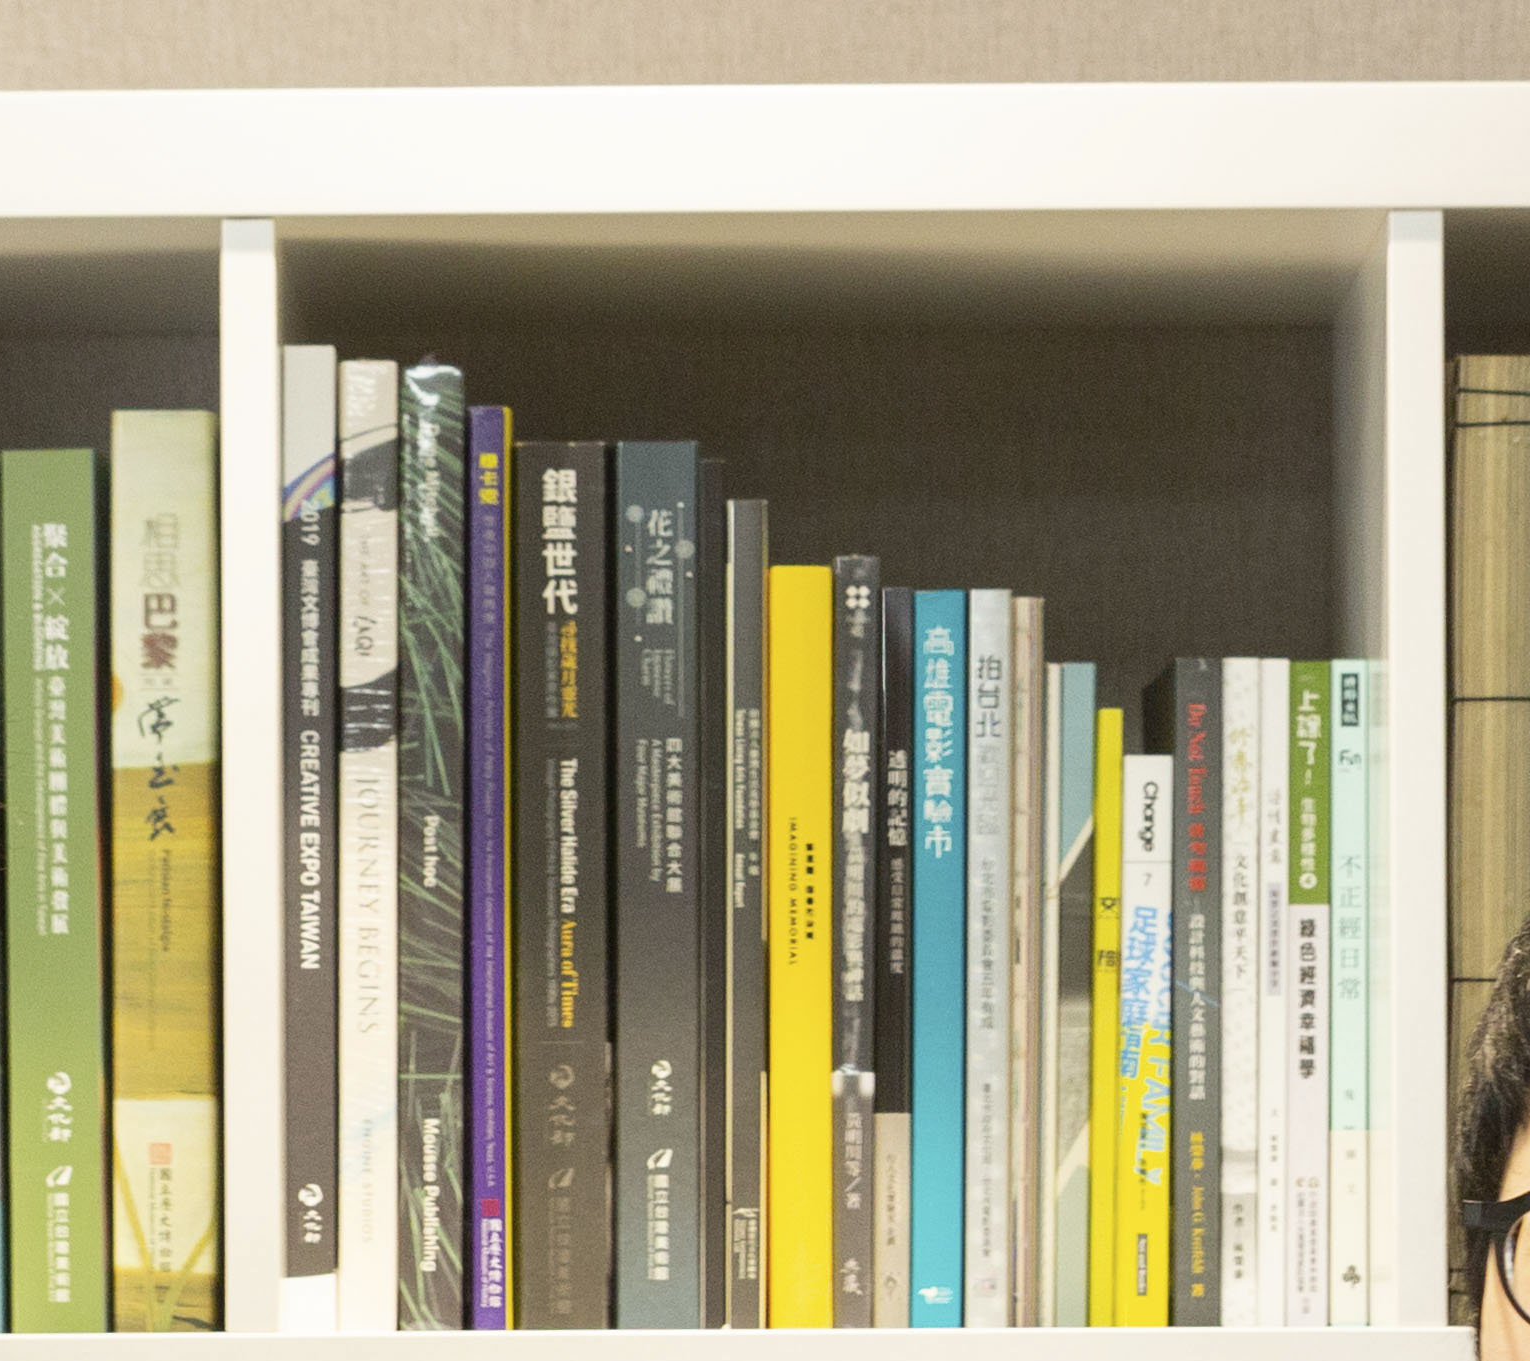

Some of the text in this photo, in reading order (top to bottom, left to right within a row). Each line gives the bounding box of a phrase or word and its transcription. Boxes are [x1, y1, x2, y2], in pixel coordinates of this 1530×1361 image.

[541, 468, 579, 615] 銀鹽世代
[976, 654, 1003, 738] 拍台北
[299, 729, 320, 827] CREATIVE
[559, 757, 579, 788] The
[1188, 703, 1208, 815] Do Not Touch
[420, 815, 438, 852] Post
[559, 789, 579, 835] Silver
[1142, 781, 1159, 853] Change
[299, 832, 320, 886] EXPO
[559, 836, 579, 886] Halide
[356, 776, 382, 1035] JOURNEY BEGINS
[559, 887, 579, 914] Era
[788, 817, 798, 966] IMAGINING MEMORIAL
[299, 889, 320, 970] TAIWAN
[559, 919, 578, 958] Aura
[559, 978, 579, 1029] Times
[1298, 919, 1316, 1079] 綠色經濟幸福學
[46, 1095, 73, 1143] 文化部
[651, 1079, 673, 1116] 文化部
[419, 1118, 439, 1273] Mousse Publishing
